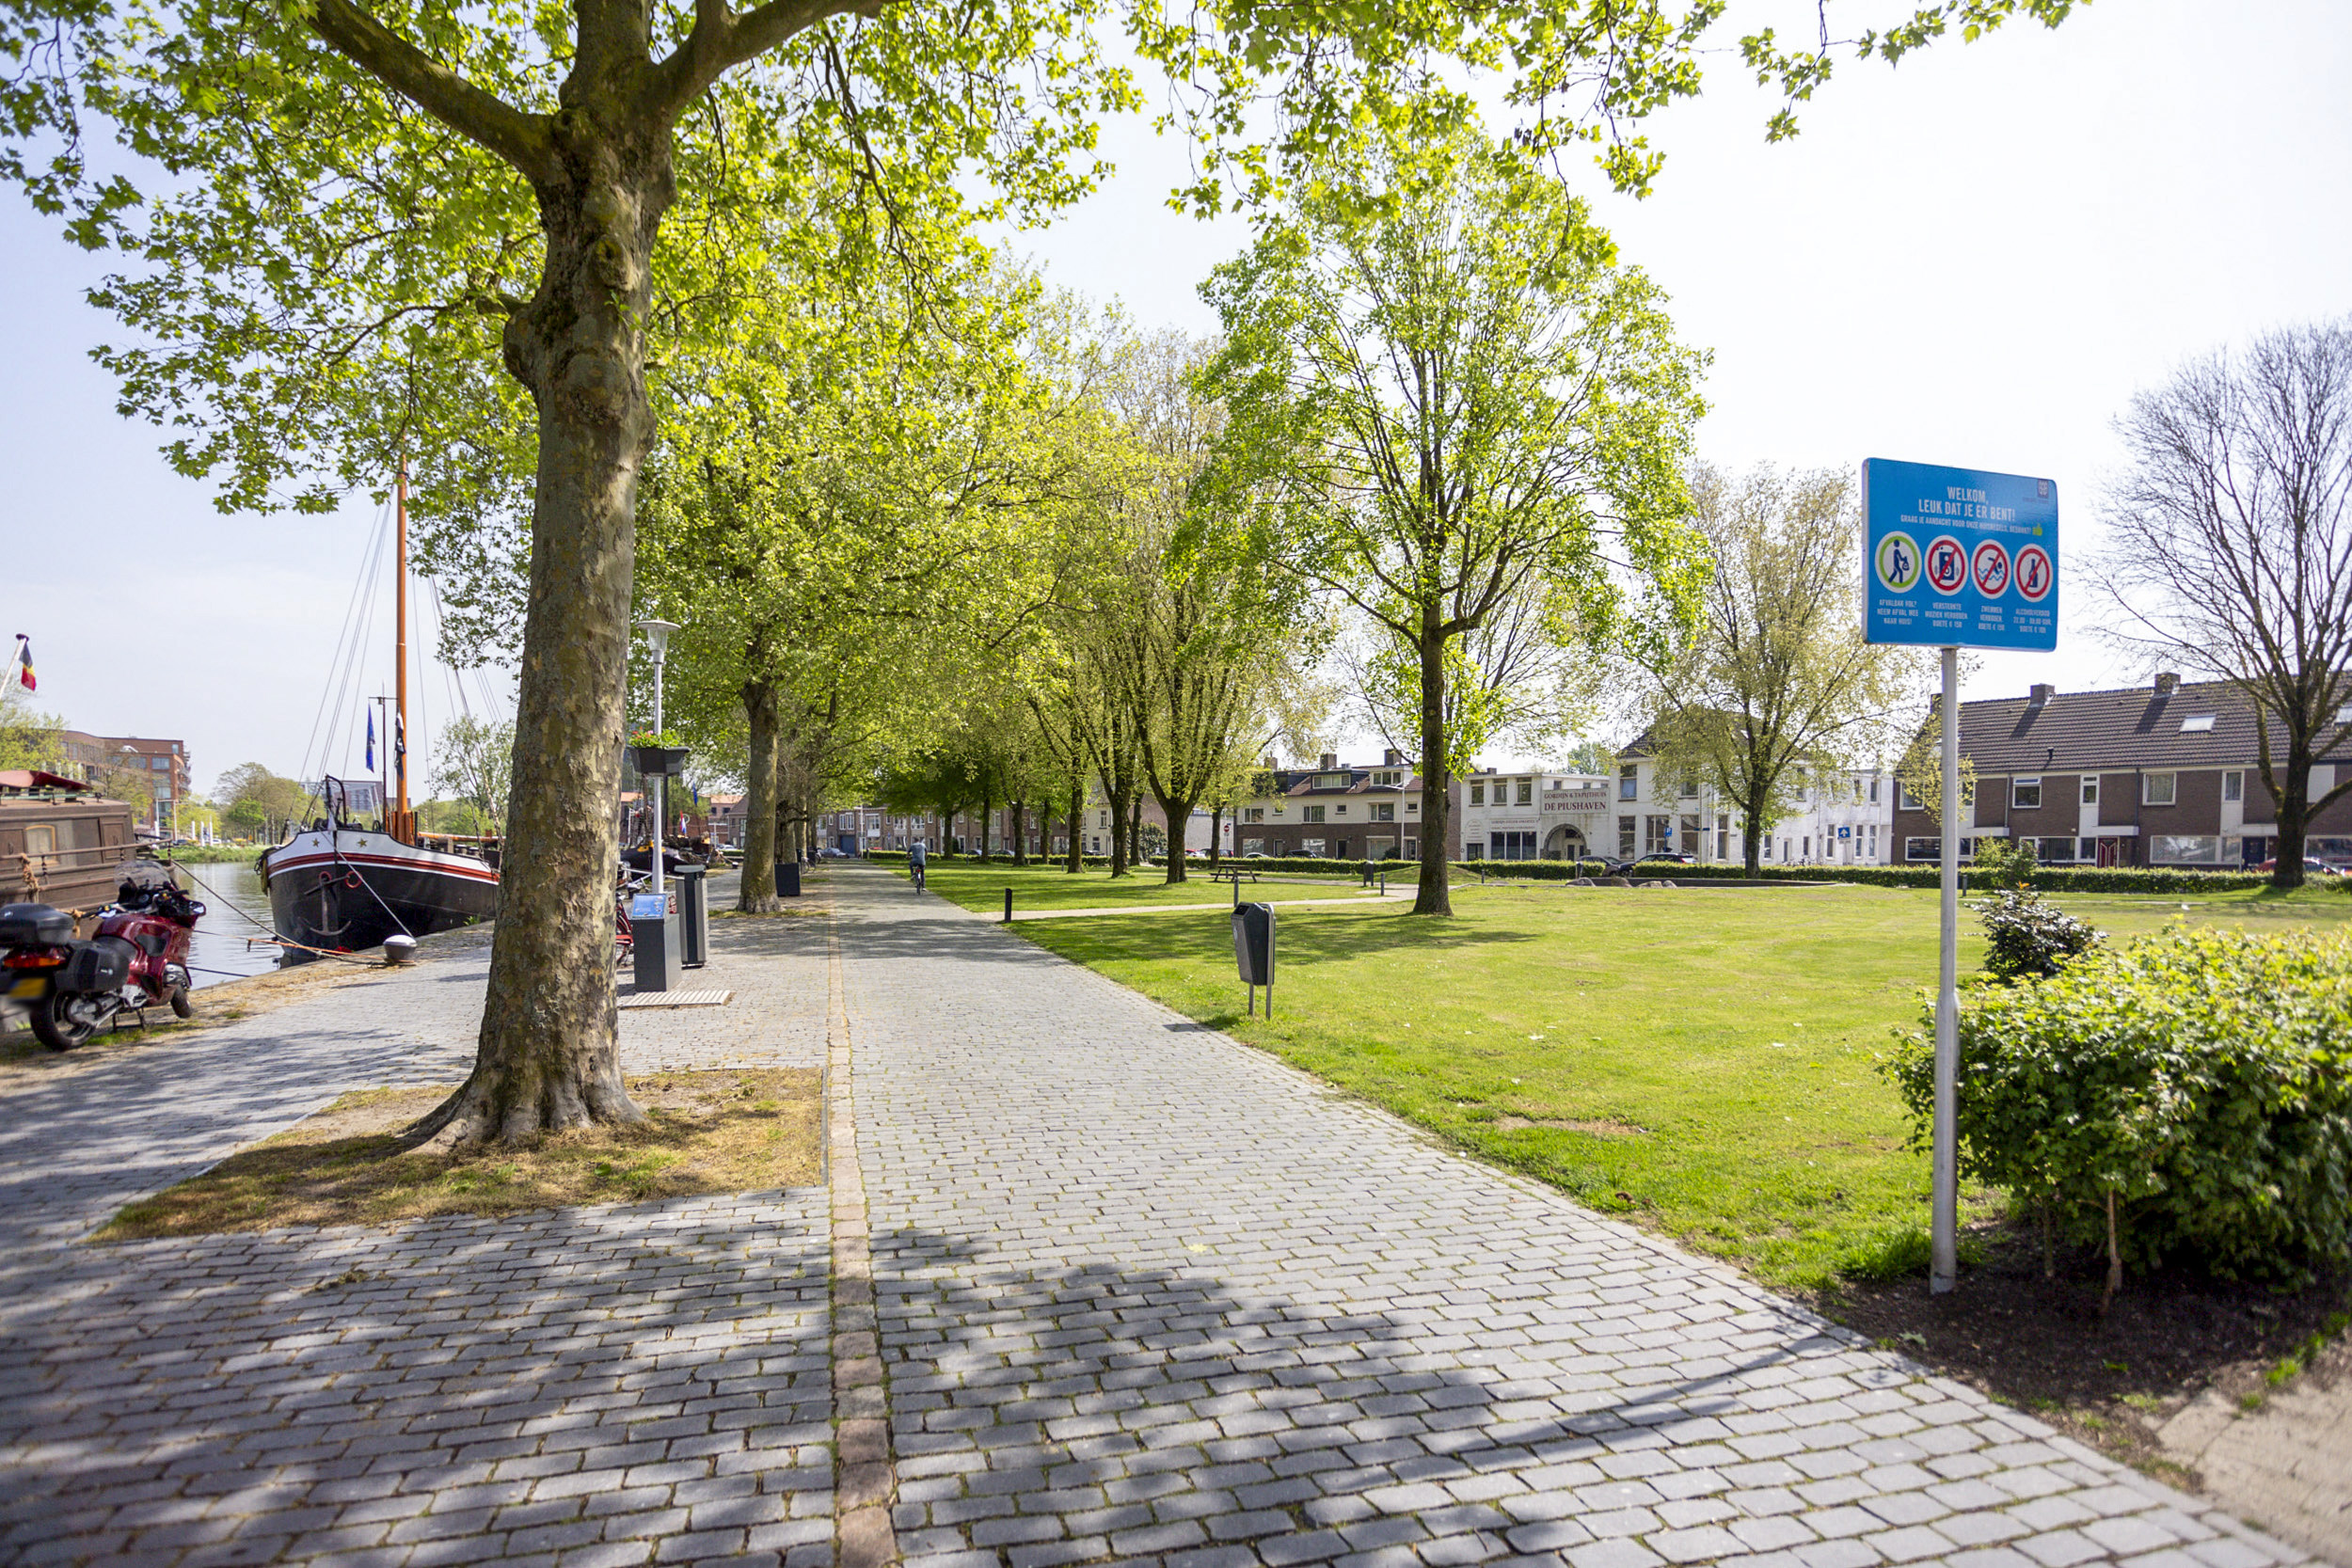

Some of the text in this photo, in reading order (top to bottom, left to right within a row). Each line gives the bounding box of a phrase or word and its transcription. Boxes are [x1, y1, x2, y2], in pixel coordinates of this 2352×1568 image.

[1947, 485, 1989, 504] WELKOM,
[1918, 499, 2015, 521] LEUK DAT JE ER BENT!
[1966, 520, 1979, 529] ONZE
[1544, 801, 1606, 811] DE PIUSHAVEN
